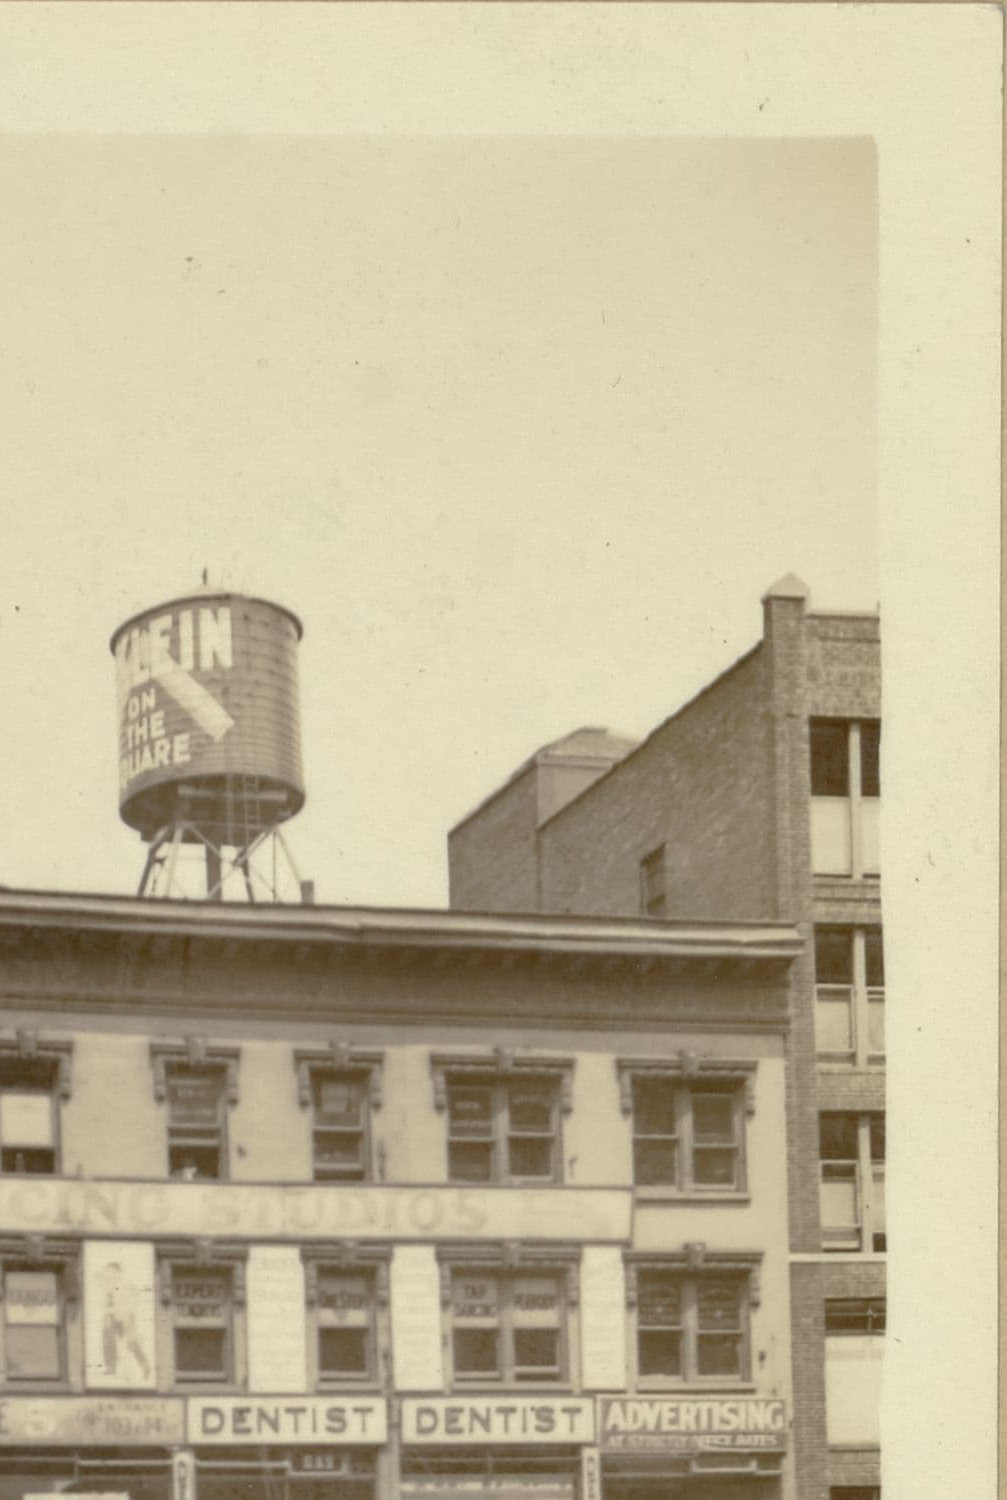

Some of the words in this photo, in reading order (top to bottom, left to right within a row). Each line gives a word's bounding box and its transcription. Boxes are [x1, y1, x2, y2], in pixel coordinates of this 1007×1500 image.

[201, 1406, 374, 1436] DENTIST
[415, 1406, 584, 1436] DENTIST
[606, 1401, 783, 1432] ADVERTISING
